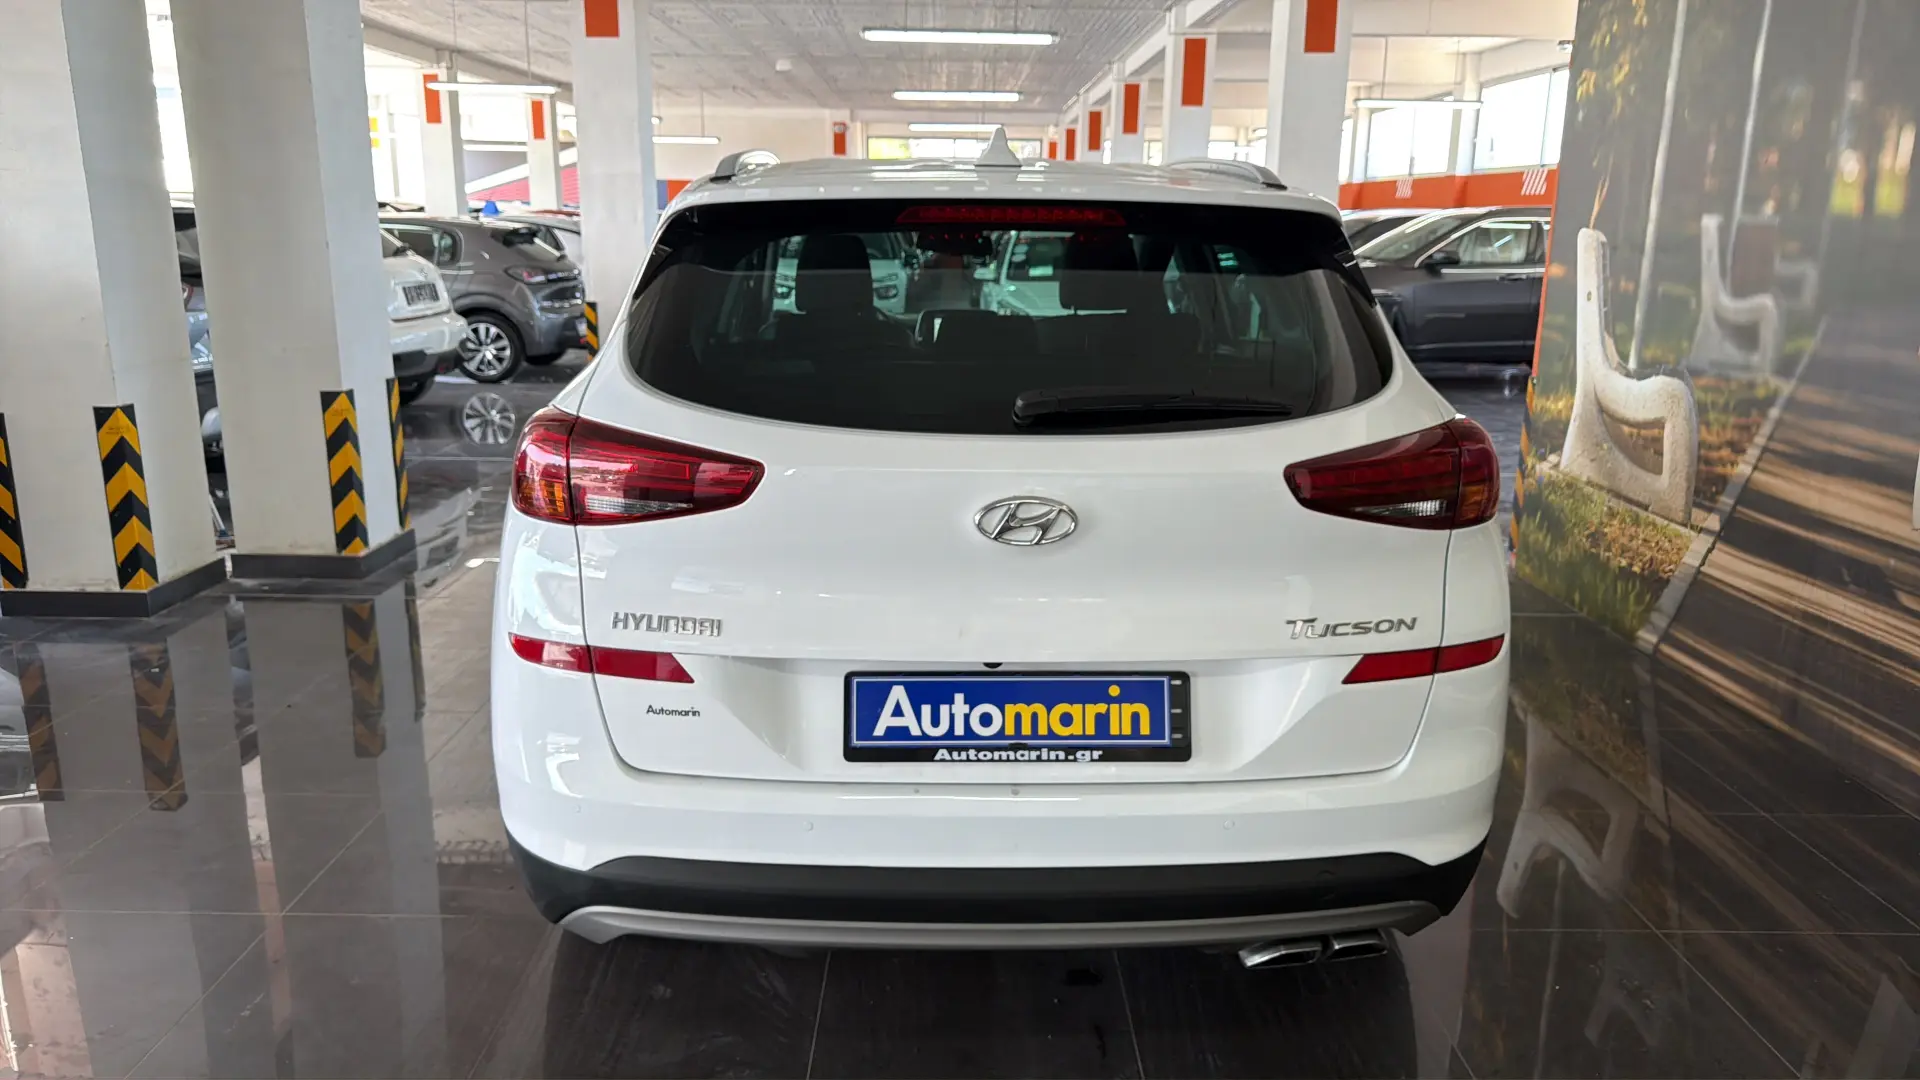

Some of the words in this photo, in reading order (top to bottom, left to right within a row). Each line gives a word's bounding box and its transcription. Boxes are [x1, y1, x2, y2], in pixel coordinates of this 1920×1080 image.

[612, 611, 722, 636] HYUNDAI
[1284, 616, 1418, 640] TUCSON
[646, 704, 701, 717] Automarin
[872, 684, 1151, 737] Automarin
[933, 748, 1103, 762] Automarin.gr
